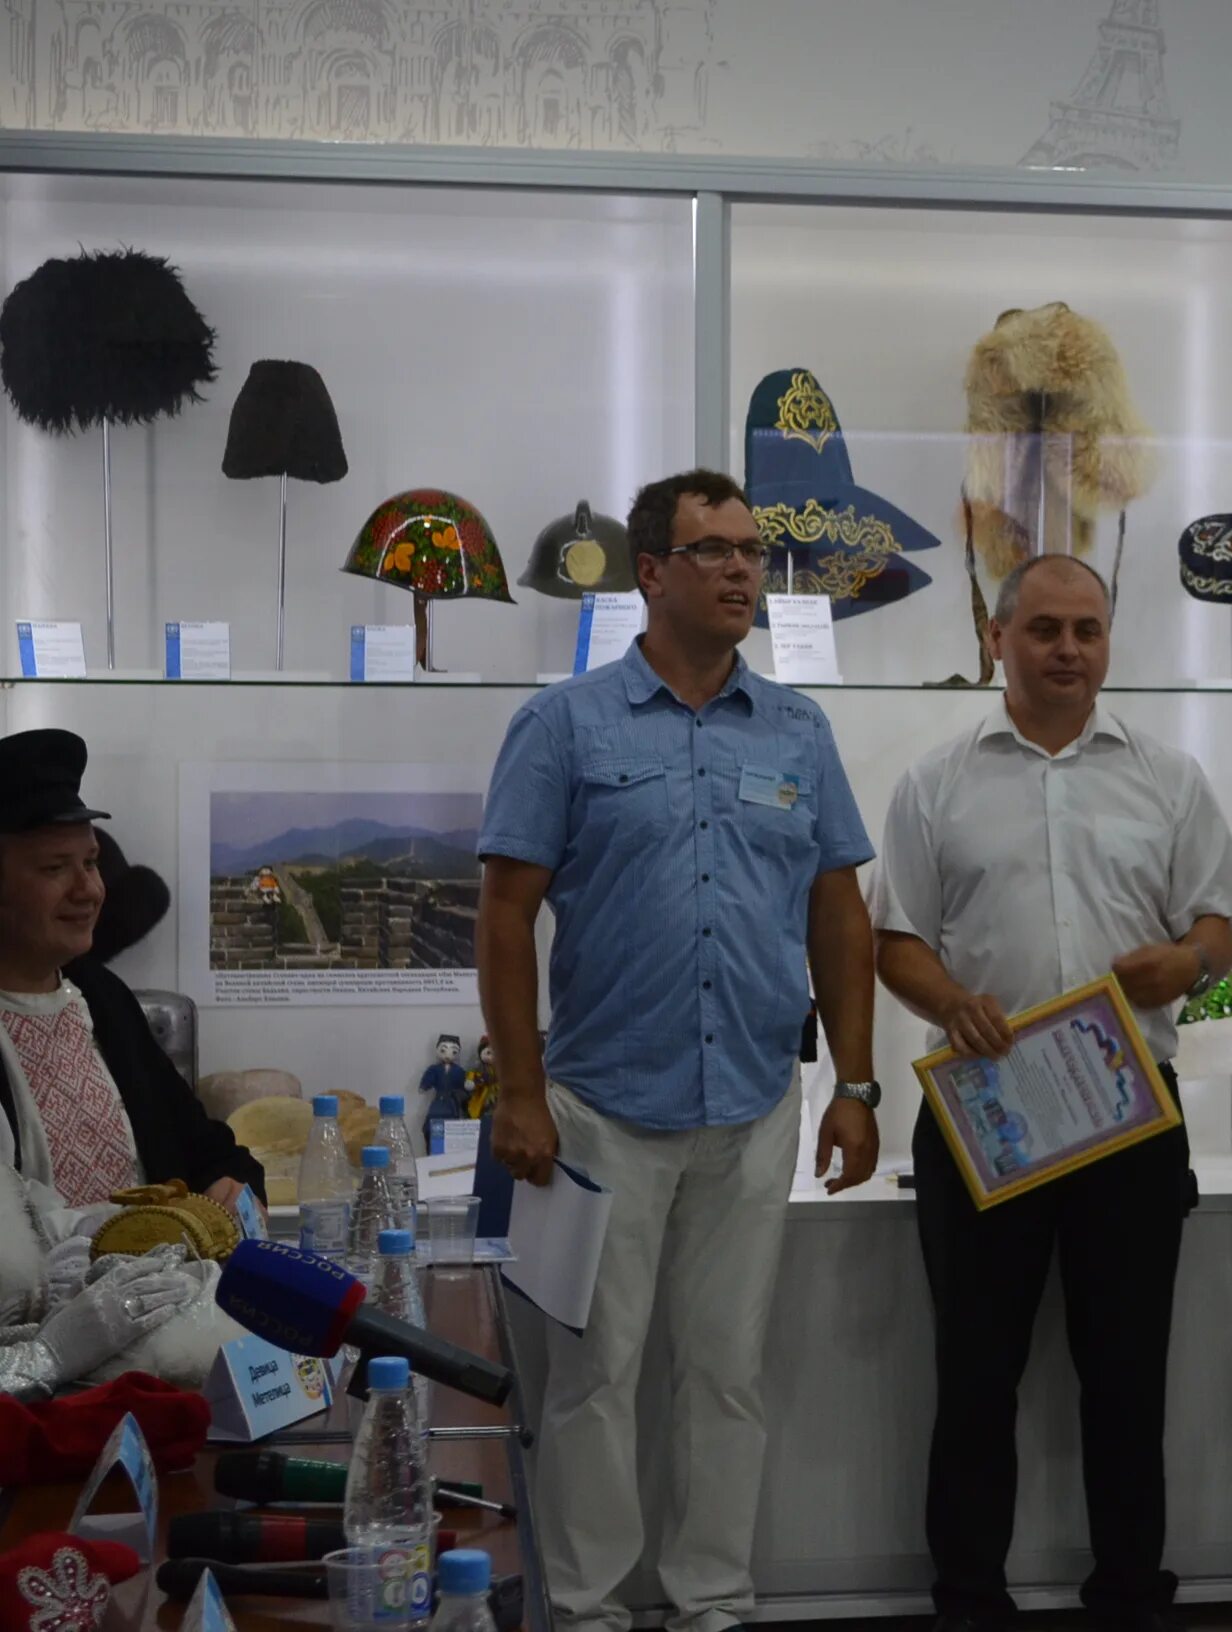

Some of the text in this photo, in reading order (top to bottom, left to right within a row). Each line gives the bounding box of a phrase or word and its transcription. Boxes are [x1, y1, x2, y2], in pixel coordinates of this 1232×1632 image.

[256, 1242, 346, 1281] РОССИЯ
[230, 1295, 314, 1346] РОССИЯ
[248, 1360, 280, 1384] Девица
[252, 1382, 292, 1408] Метелица
